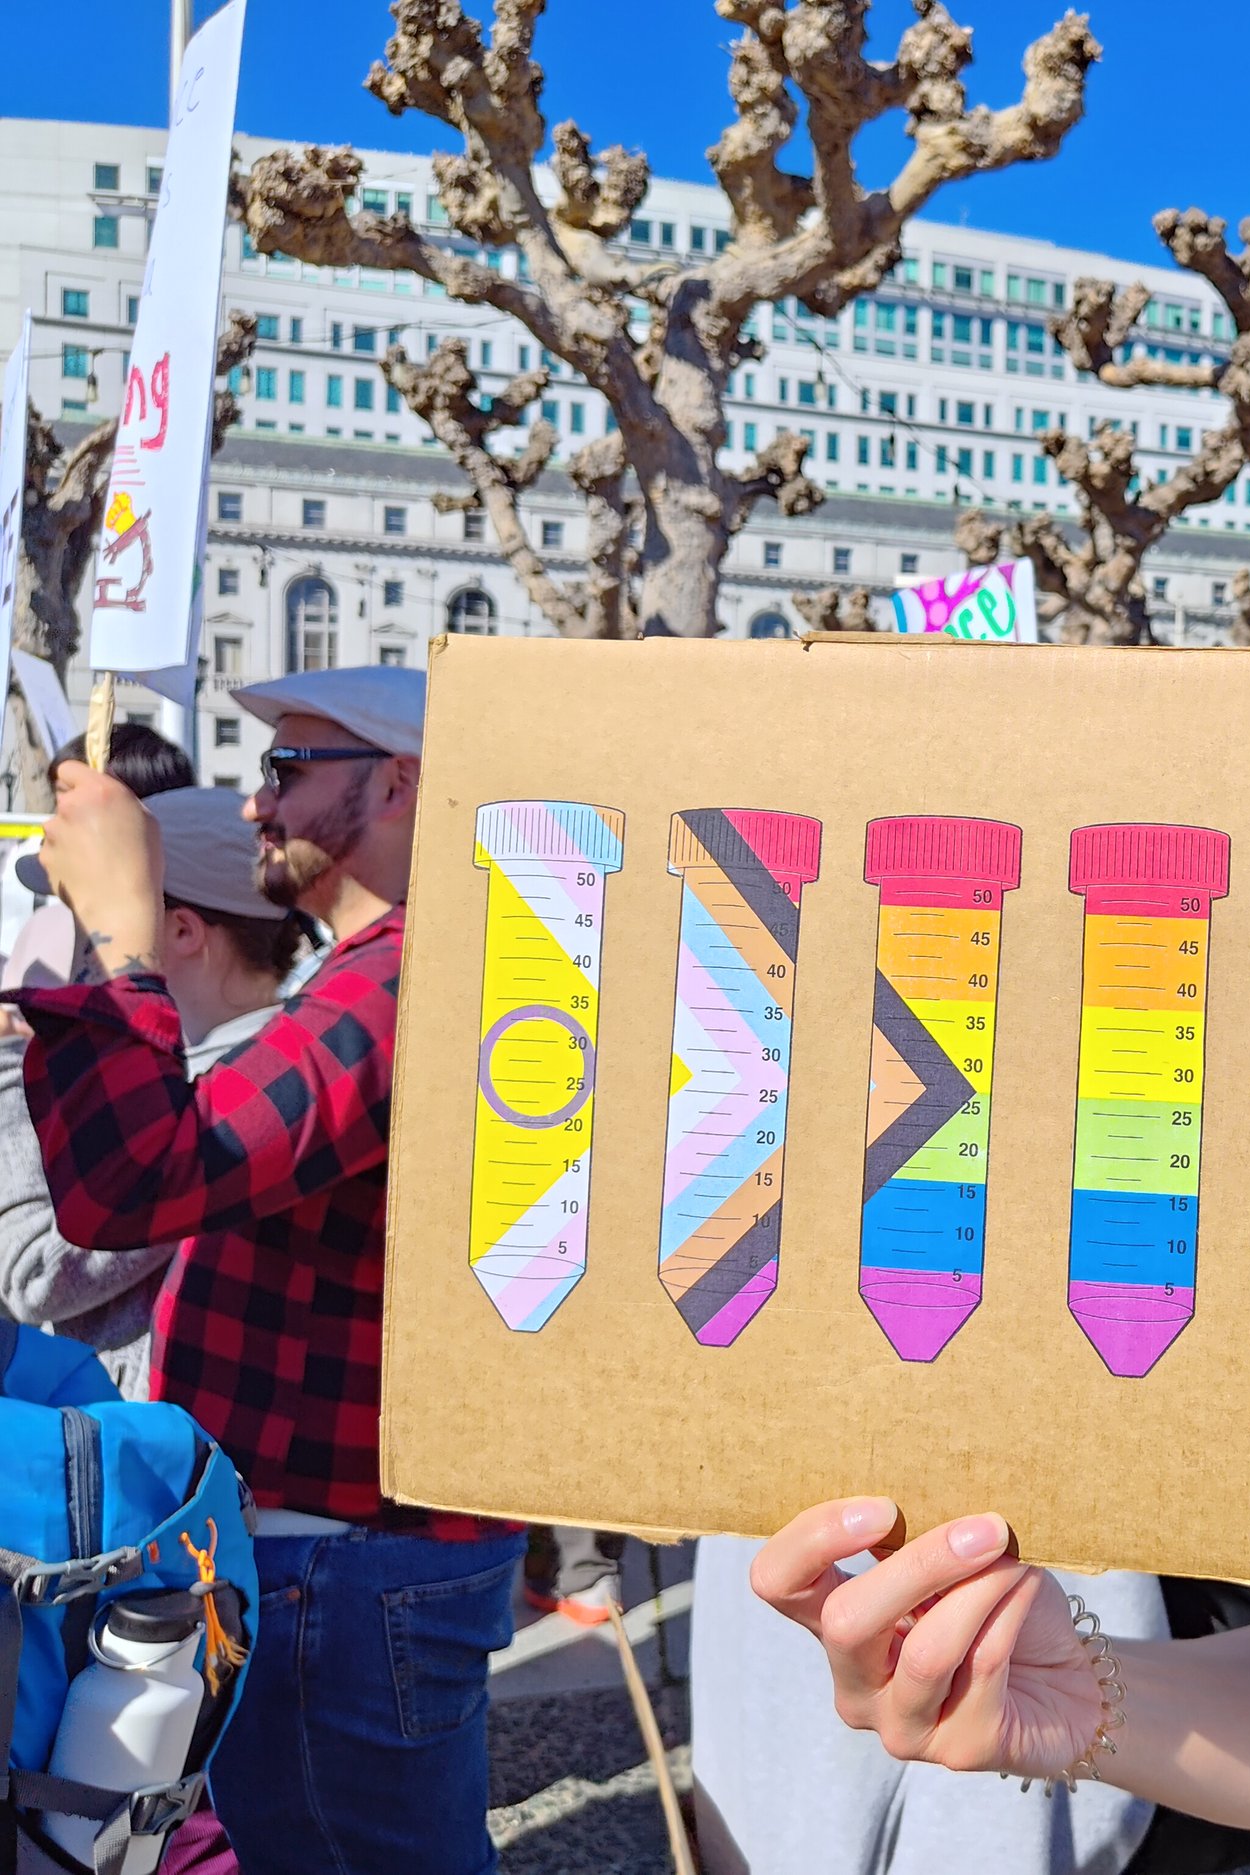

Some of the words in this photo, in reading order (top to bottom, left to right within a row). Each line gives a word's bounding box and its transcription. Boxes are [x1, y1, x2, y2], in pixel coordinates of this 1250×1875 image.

[575, 872, 597, 888] 50
[971, 888, 994, 904] 50
[1179, 896, 1202, 913] 50
[573, 913, 594, 929] 45
[969, 931, 992, 947] 45
[1177, 940, 1200, 956] 45
[572, 954, 593, 970] 40
[765, 964, 787, 979] 40
[967, 973, 989, 989] 40
[1175, 982, 1198, 999] 40
[569, 995, 590, 1010] 35
[763, 1006, 784, 1022] 35
[965, 1015, 987, 1031] 35
[1174, 1025, 1196, 1041] 35
[567, 1036, 589, 1051] 30
[760, 1047, 782, 1063] 30
[962, 1057, 984, 1074] 30
[565, 1076, 586, 1092] 25
[1172, 1068, 1195, 1084] 30
[758, 1089, 779, 1104] 25
[960, 1100, 982, 1116] 25
[563, 1117, 584, 1133] 20
[1170, 1110, 1194, 1127] 25
[755, 1130, 777, 1146] 20
[957, 1142, 980, 1158] 20
[561, 1159, 582, 1174] 15
[1169, 1153, 1191, 1169] 20
[753, 1172, 774, 1187] 15
[956, 1184, 978, 1200] 15
[560, 1199, 580, 1215] 10
[1168, 1196, 1189, 1212] 15
[954, 1226, 975, 1242] 10
[557, 1240, 568, 1255] 5
[1166, 1239, 1188, 1255] 10
[951, 1268, 963, 1284] 5
[1163, 1281, 1176, 1298] 5
